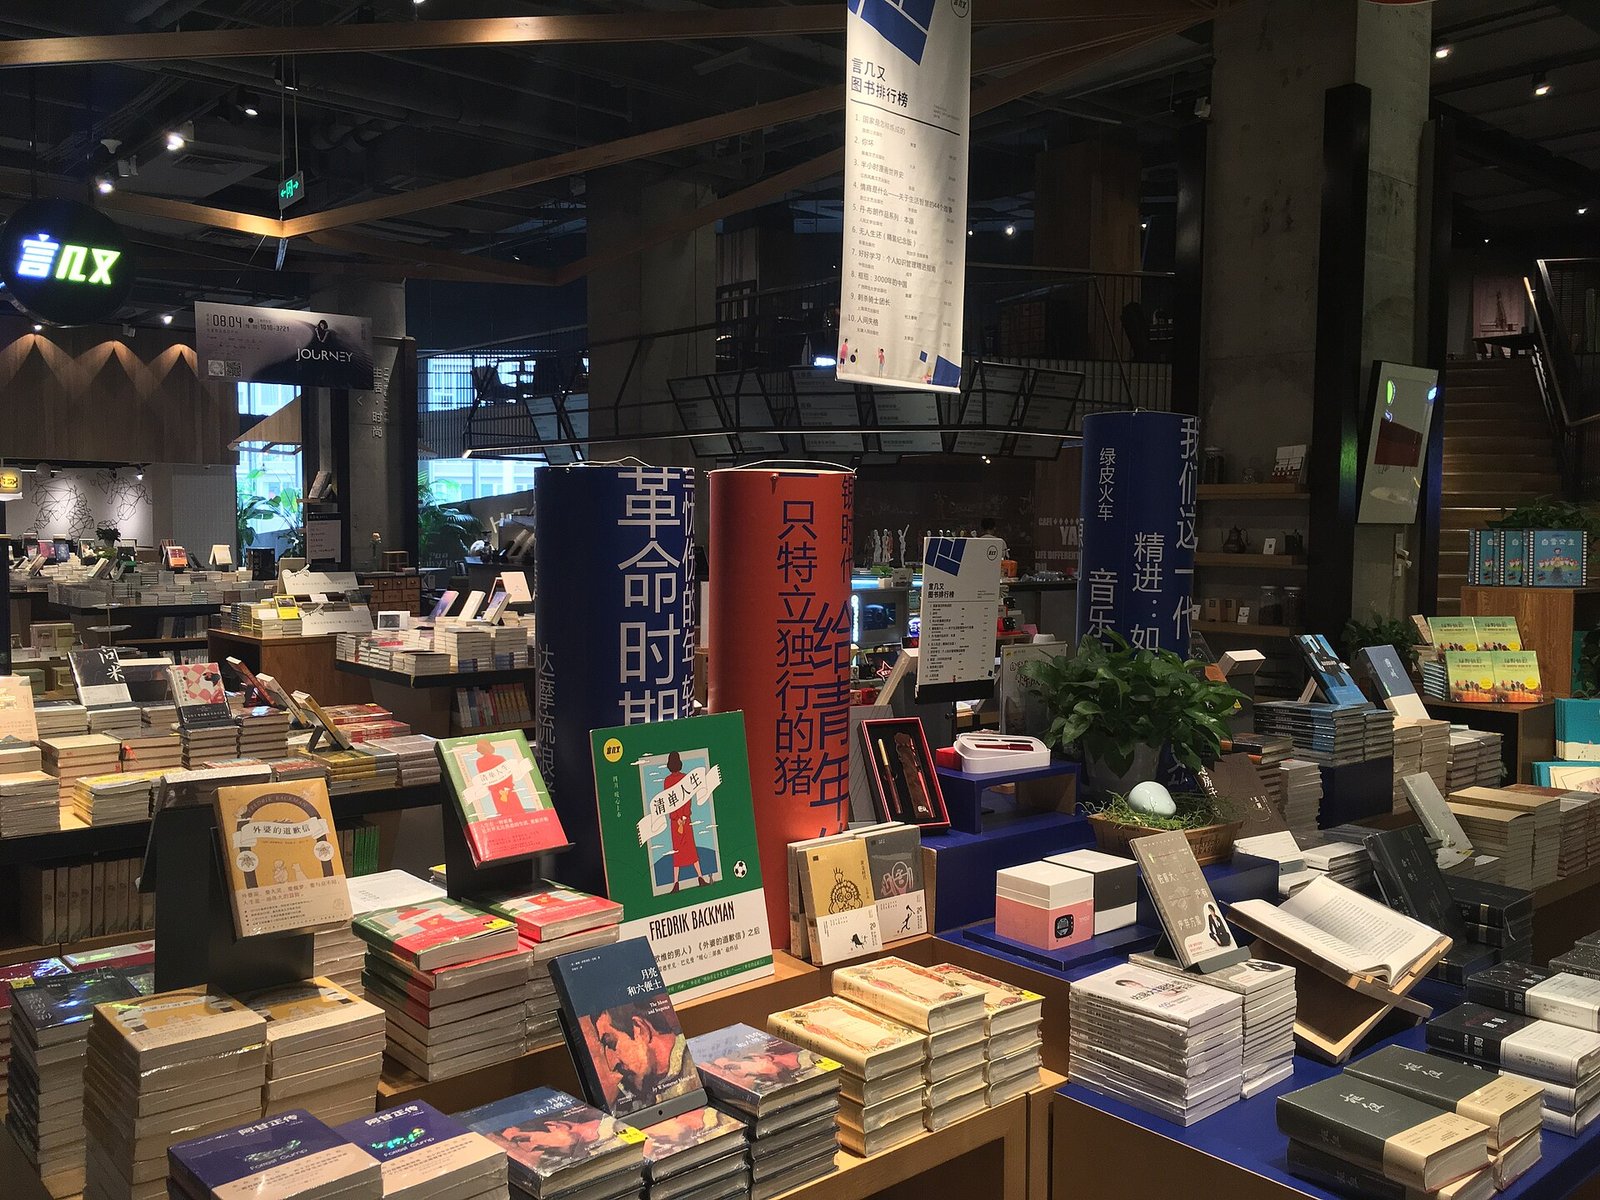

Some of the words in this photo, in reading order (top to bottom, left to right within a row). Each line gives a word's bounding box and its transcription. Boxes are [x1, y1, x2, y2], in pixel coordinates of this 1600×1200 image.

[851, 57, 886, 82] 言几又
[851, 76, 909, 108] 图书排行榜
[212, 313, 242, 329] 08.04
[296, 347, 354, 363] JOURNEY
[1097, 447, 1117, 521] 绿皮火车
[1173, 416, 1200, 640] 我们这一代
[1087, 567, 1118, 652] 音乐
[98, 647, 126, 682] 问米
[809, 601, 851, 836] 给青年
[653, 772, 703, 816] 清单人生
[648, 912, 690, 941] FREDRIK
[691, 900, 736, 930] BACKMAN
[626, 979, 664, 997] 和六便士
[640, 966, 659, 981] 月亮
[237, 1113, 298, 1136] 阿甘正传
[364, 1104, 419, 1126] 阿甘正传
